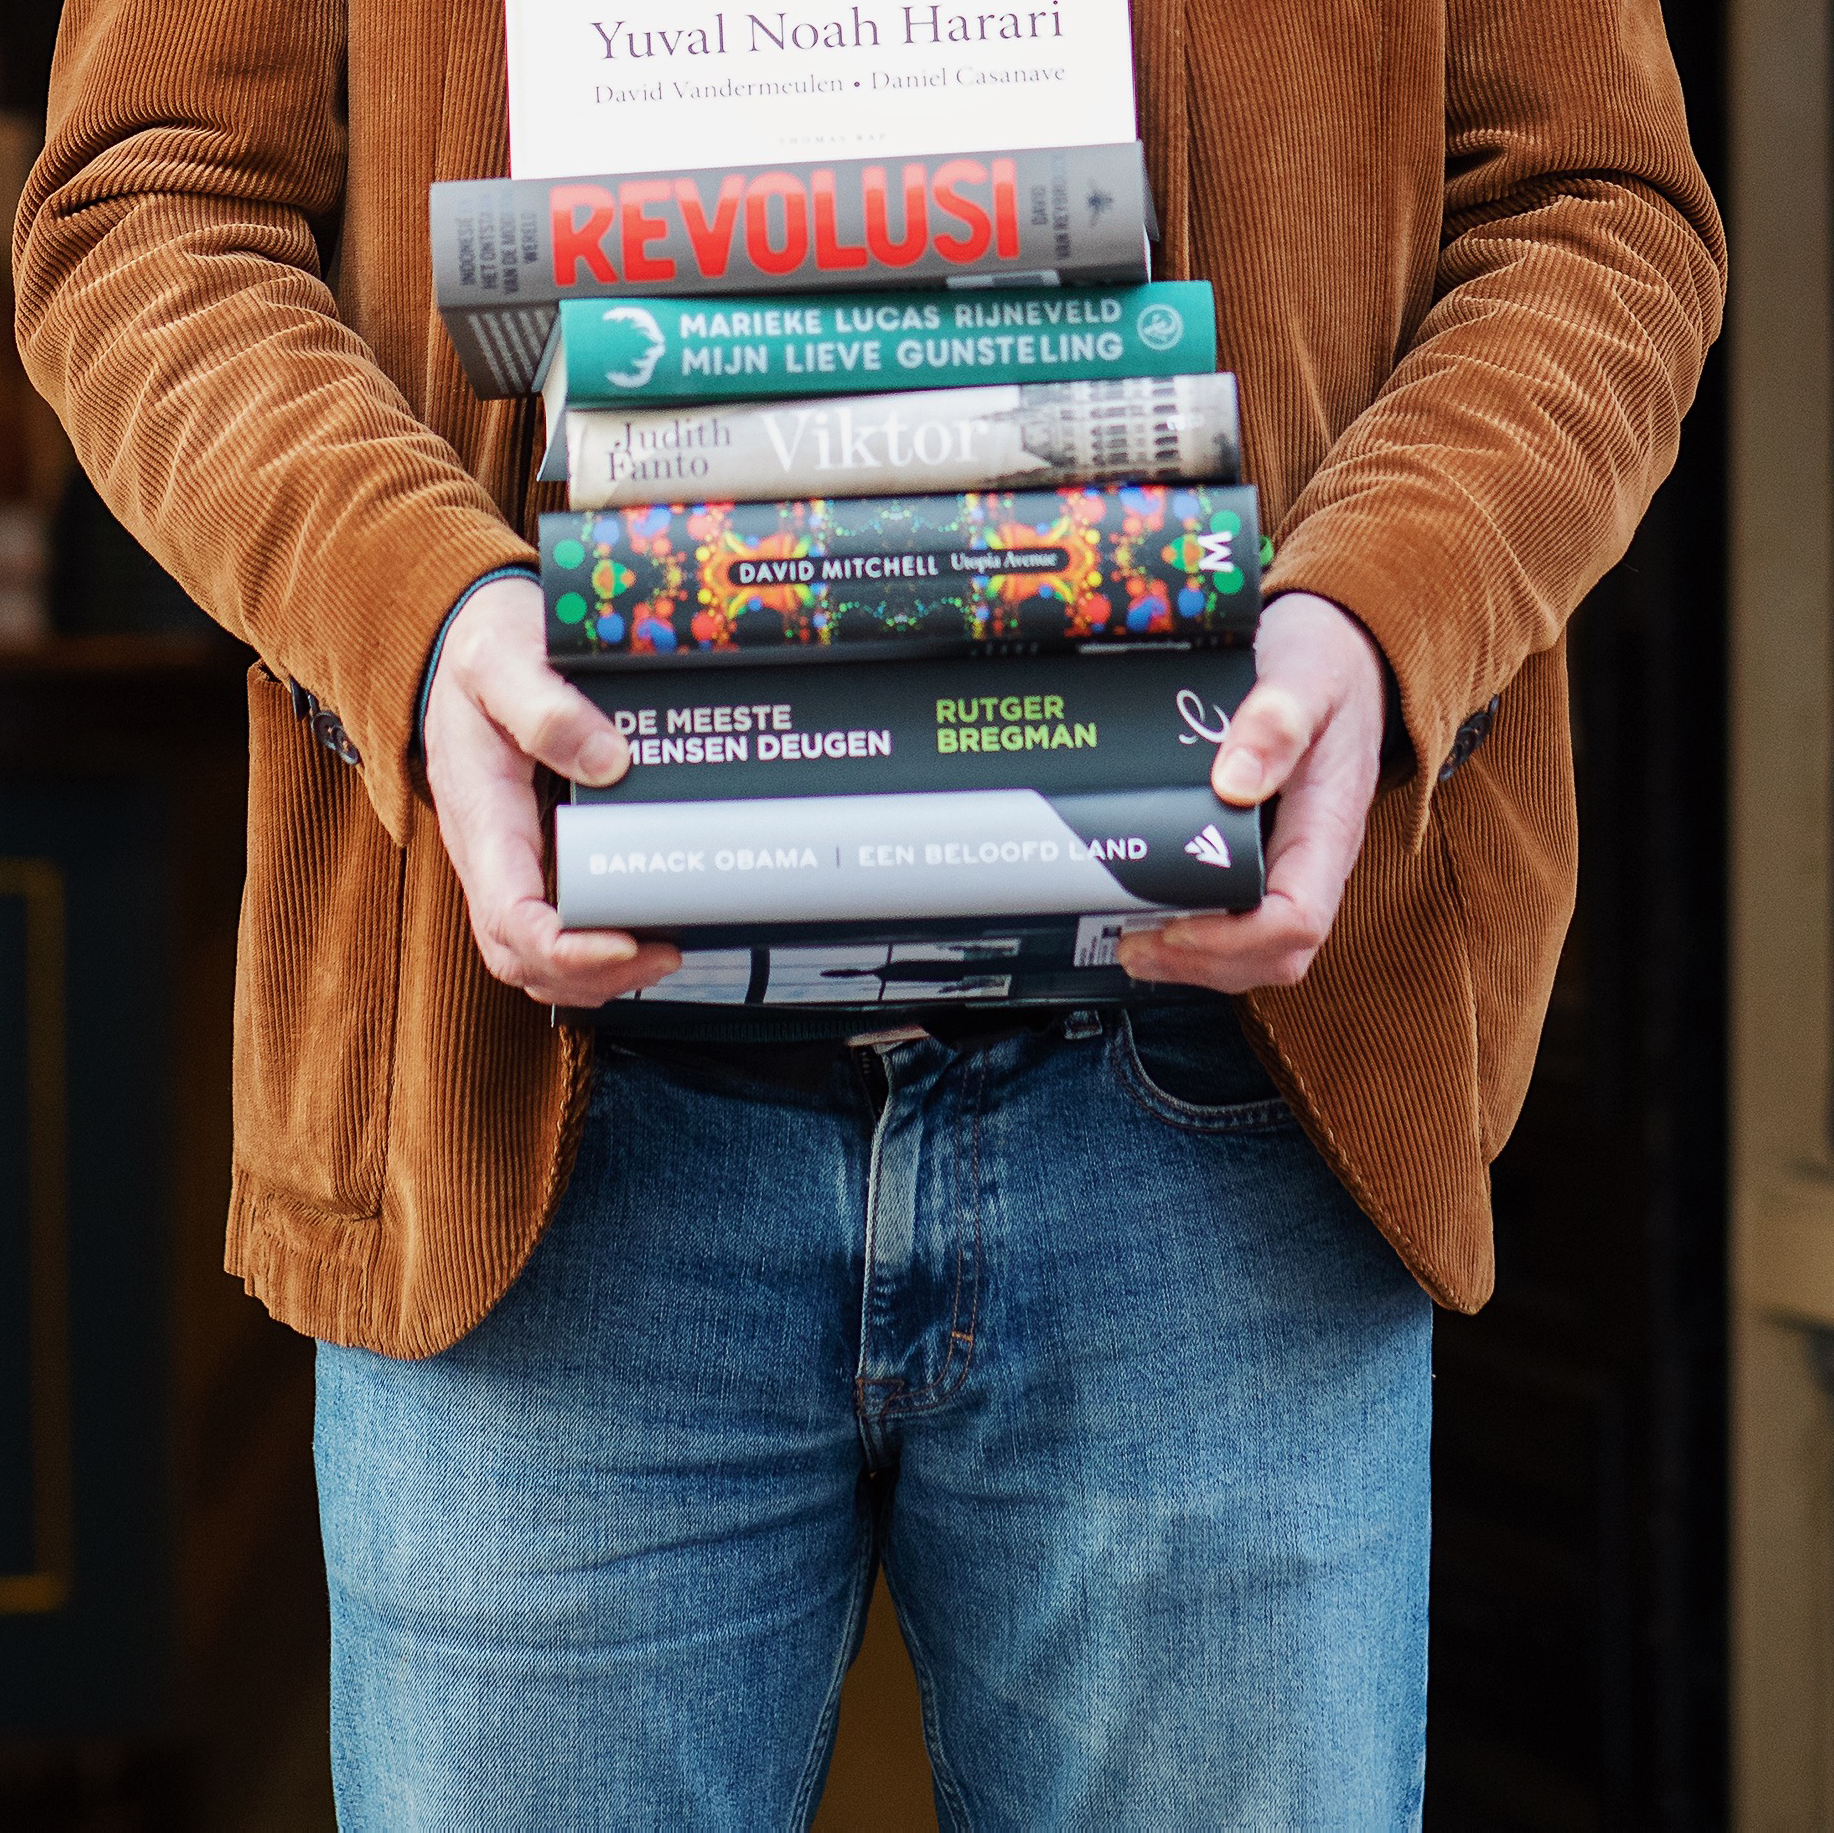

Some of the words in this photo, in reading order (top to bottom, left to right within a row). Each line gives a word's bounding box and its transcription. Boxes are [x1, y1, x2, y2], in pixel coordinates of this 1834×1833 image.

[590, 13, 729, 60] Yuval
[745, 6, 880, 53] Noah
[595, 81, 664, 104] David
[673, 73, 844, 100] Vandermeulen
[871, 67, 948, 91] Daniel
[956, 63, 1067, 86] Casanave
[549, 157, 1020, 287] REVOLUSI
[1030, 185, 1048, 226] DAVID
[521, 211, 538, 264] WERELD
[1054, 233, 1071, 261] VAN
[501, 249, 517, 265] DE
[480, 264, 497, 290] HET
[502, 268, 518, 295] VAN
[679, 308, 822, 339] MARIEKE
[835, 303, 940, 334] LUCAS
[955, 298, 1122, 329] RIJNEVELD
[680, 346, 768, 377] MIJN
[786, 341, 881, 373] LIEVE
[896, 331, 1124, 369] GUNSTELING
[614, 416, 733, 455] Judith
[760, 406, 989, 474] Viktor
[607, 451, 710, 484] Fanto
[738, 559, 815, 584] DAVID
[821, 555, 940, 581] MITCHELL
[950, 551, 1002, 573] Utopia
[1003, 549, 1059, 569] Avenue
[614, 709, 658, 736] DE
[667, 704, 793, 735] MEESTE
[936, 695, 1064, 724] RUTGER
[757, 729, 891, 762] DEUGEN
[936, 722, 1098, 754] BREGMAN
[589, 850, 705, 875] BARACK
[714, 847, 818, 871] OBAMA
[858, 844, 914, 867] EEN
[924, 840, 1060, 865] BELOOFD
[1068, 837, 1148, 862] LAND
